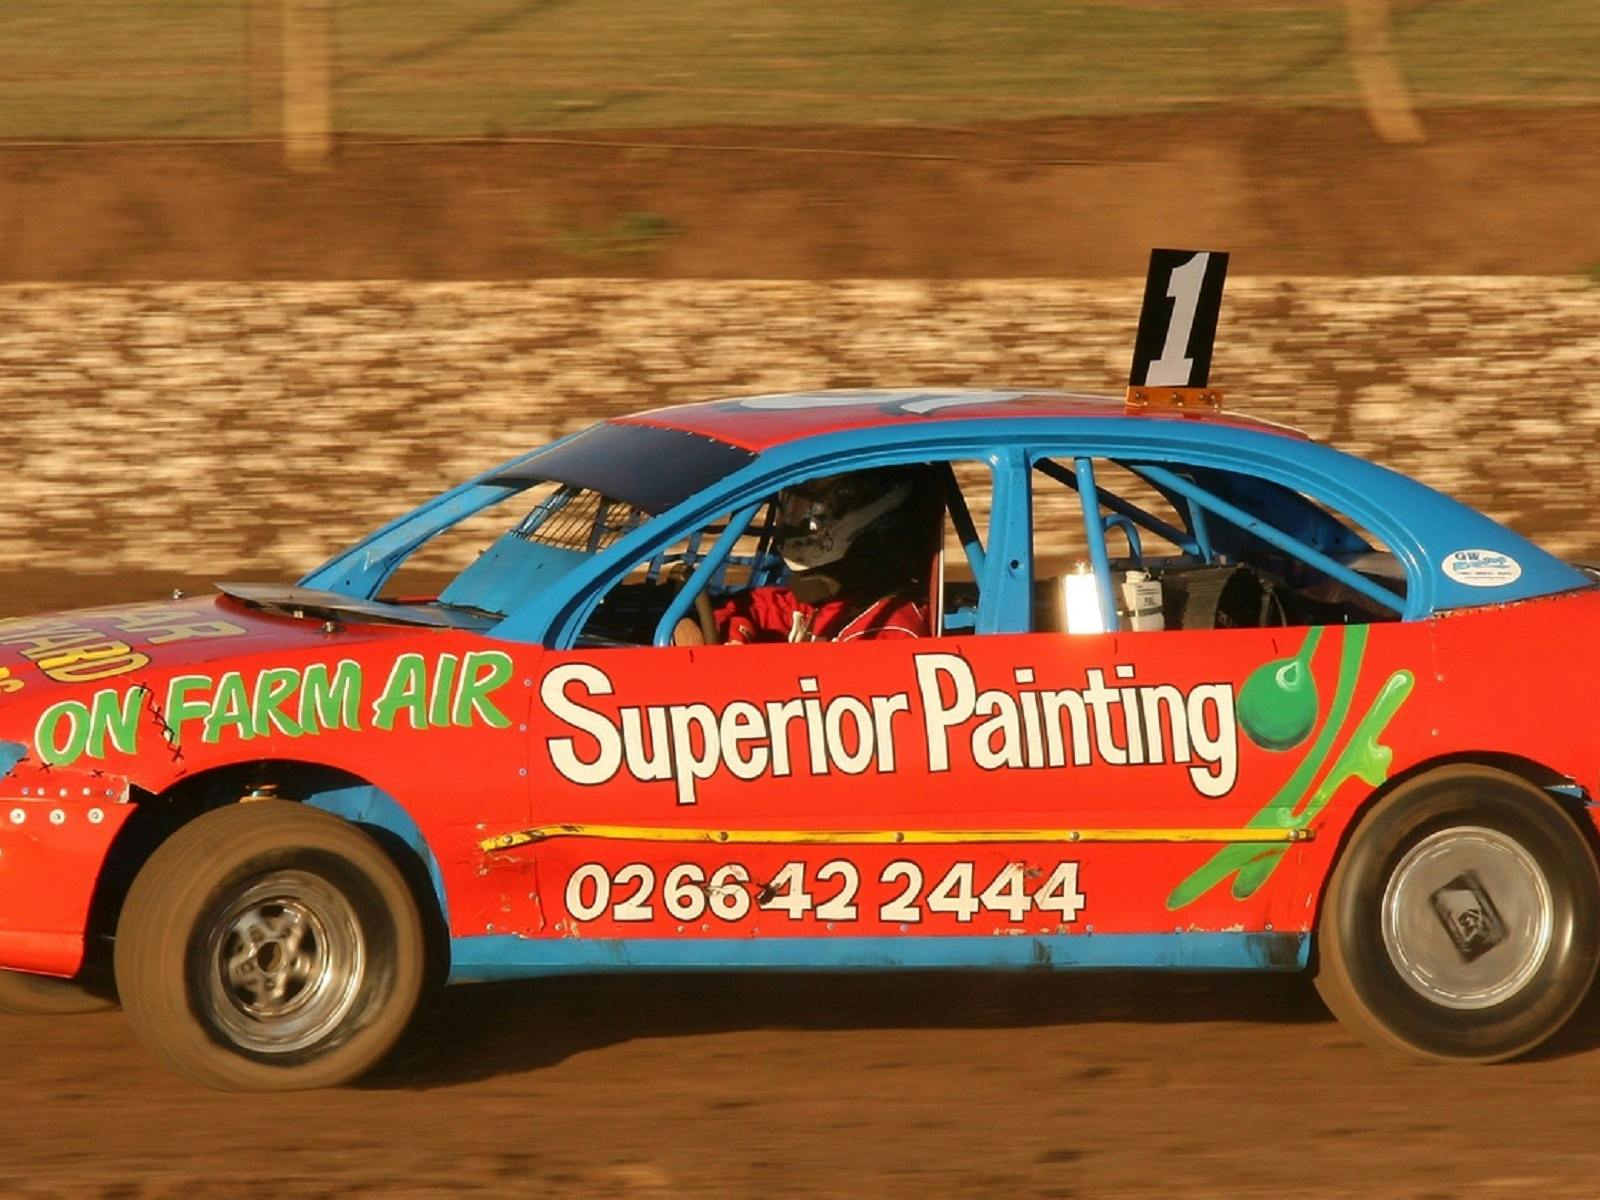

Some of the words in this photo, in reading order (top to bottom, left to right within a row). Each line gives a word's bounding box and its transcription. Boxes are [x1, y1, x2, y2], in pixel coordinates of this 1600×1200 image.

[1145, 252, 1210, 387] 1
[34, 686, 148, 766] ON
[164, 659, 362, 746] FARM
[371, 650, 513, 730] AIR
[540, 662, 911, 806] Superior
[913, 652, 1239, 799] Painting
[878, 858, 1085, 923] 2444
